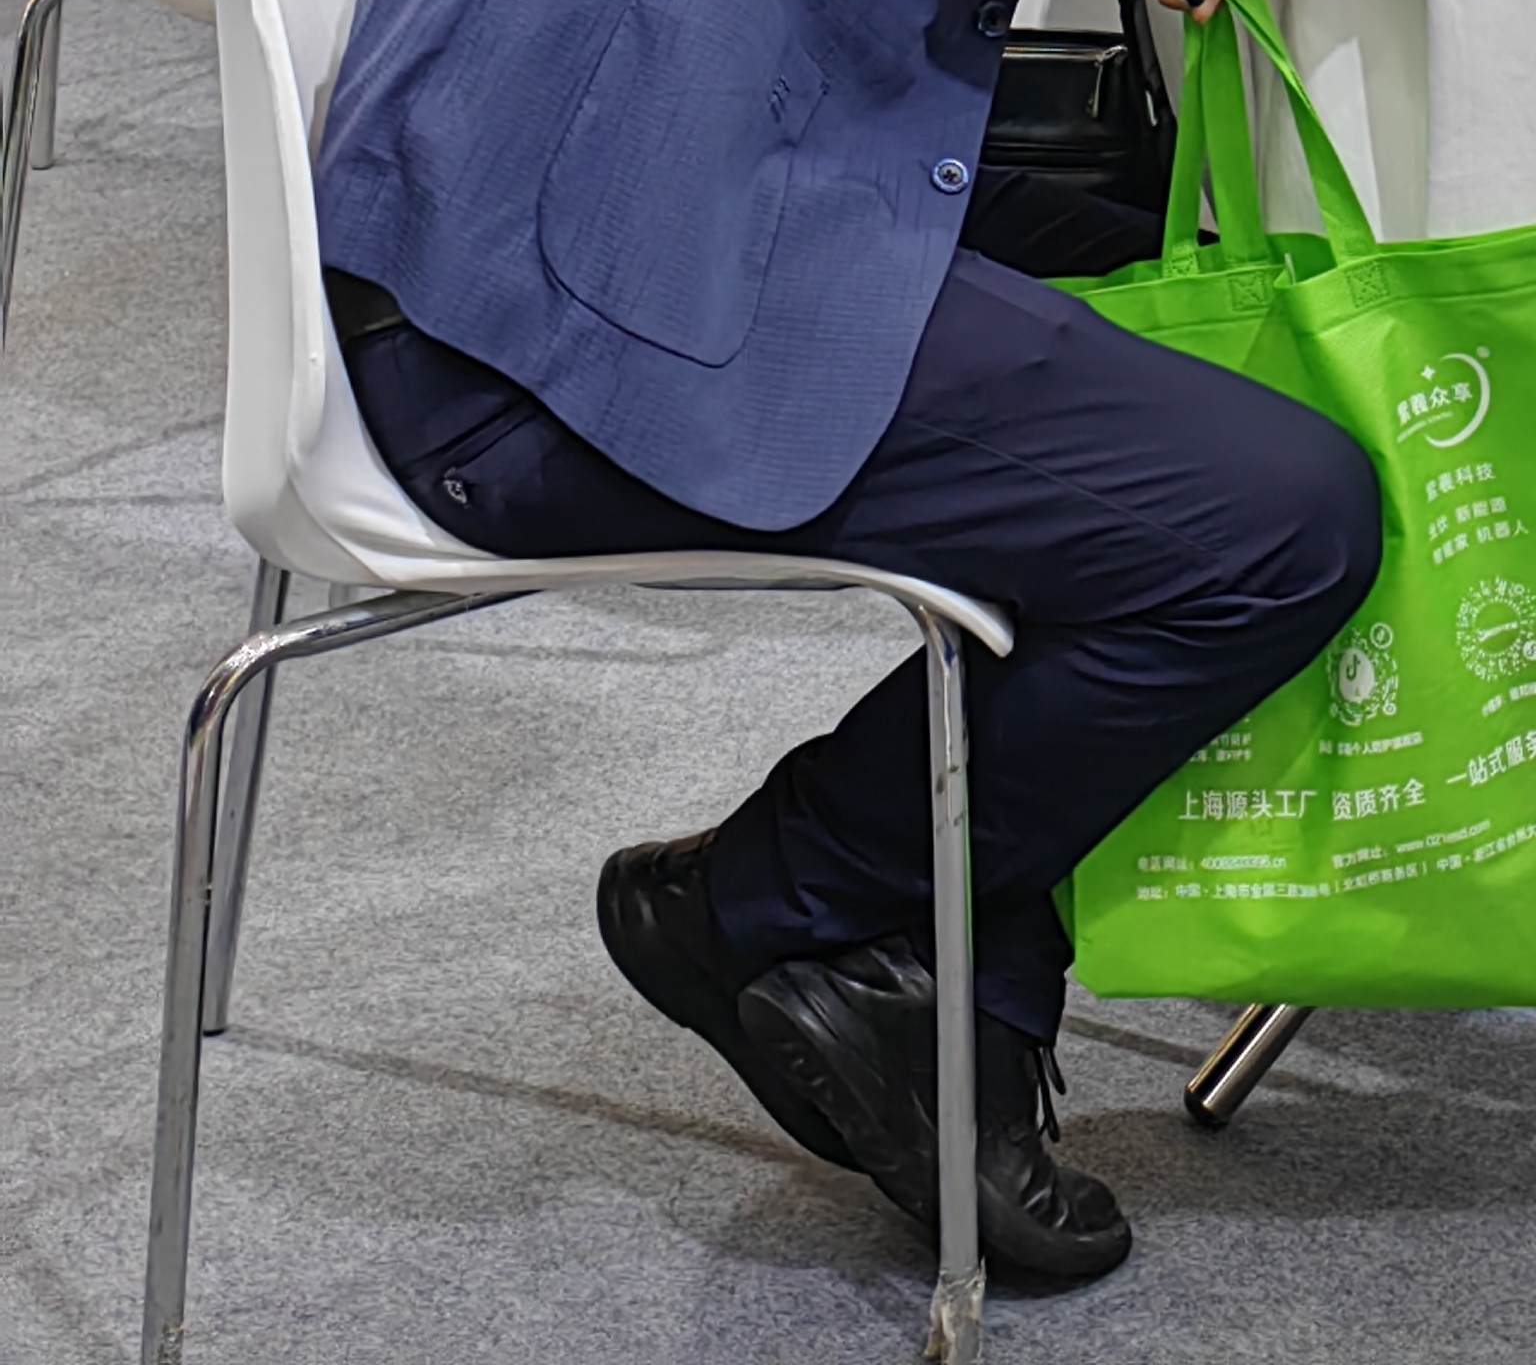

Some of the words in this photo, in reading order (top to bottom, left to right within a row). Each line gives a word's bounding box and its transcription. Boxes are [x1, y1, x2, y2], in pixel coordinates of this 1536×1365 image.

[1179, 790, 1318, 821] 上海源头工厂
[1332, 778, 1426, 821] 资质齐全
